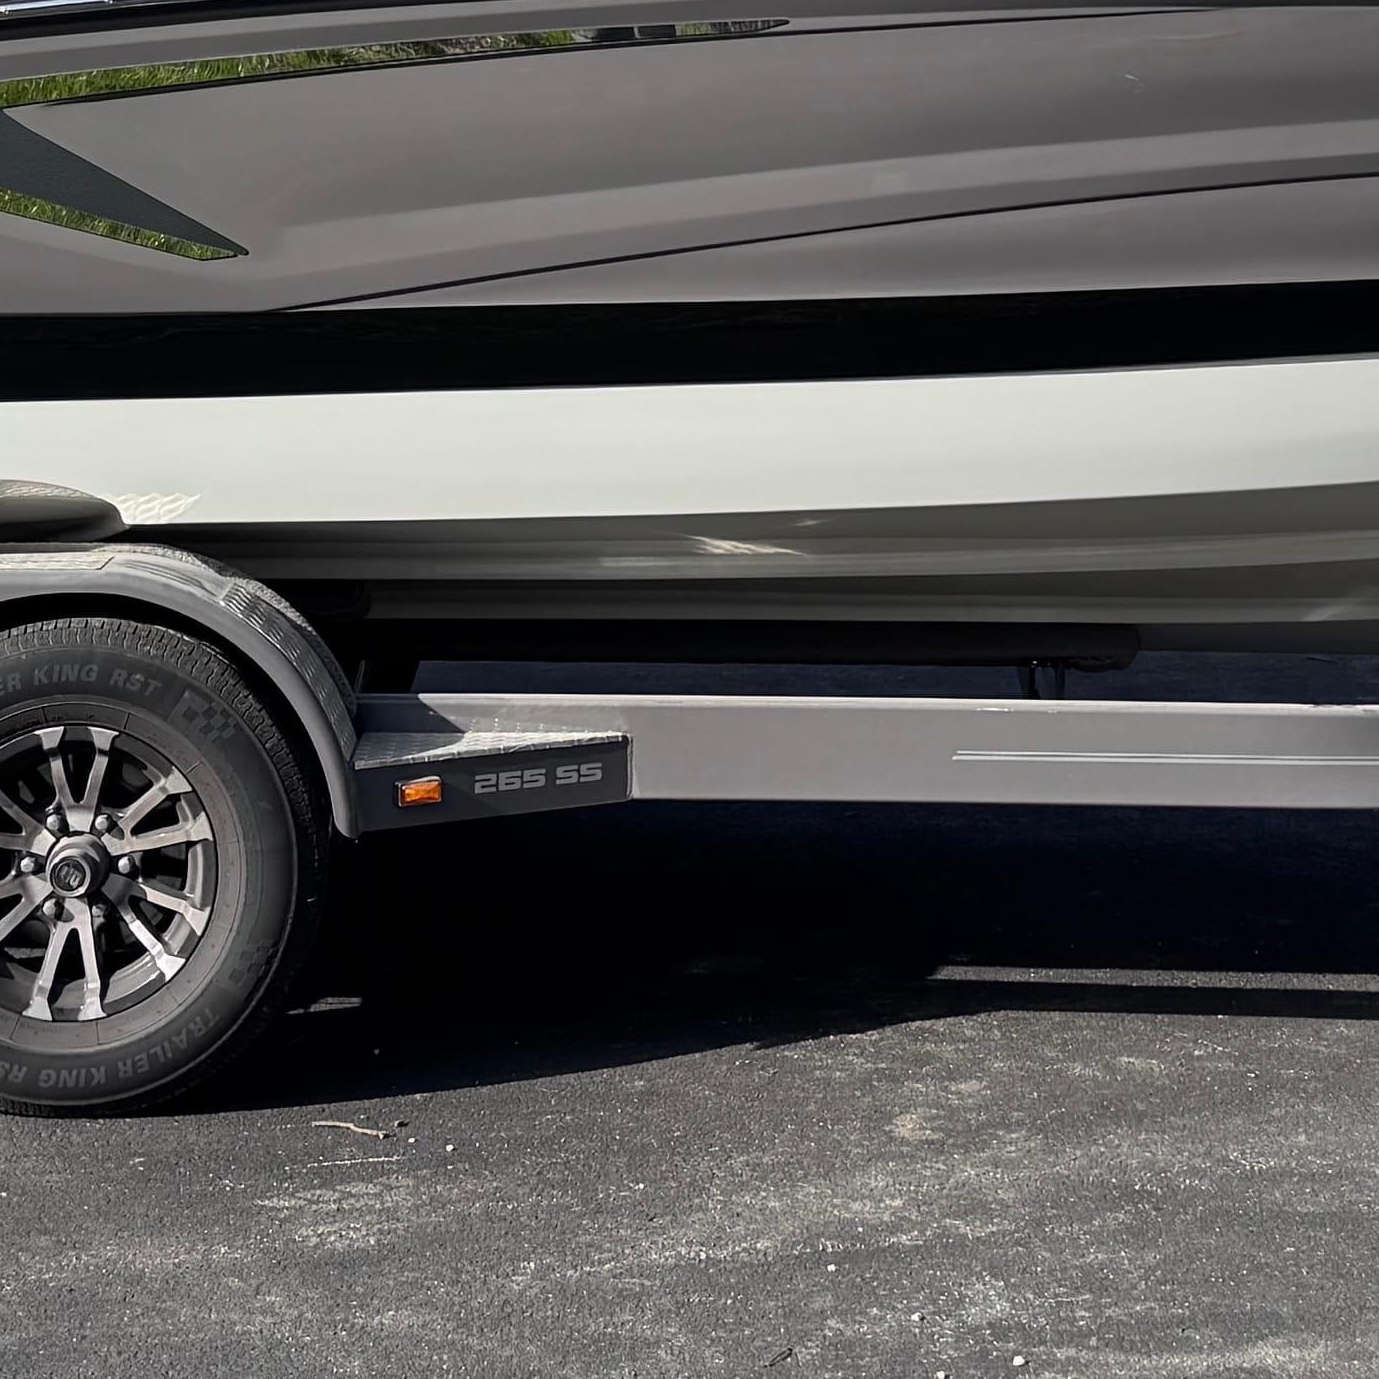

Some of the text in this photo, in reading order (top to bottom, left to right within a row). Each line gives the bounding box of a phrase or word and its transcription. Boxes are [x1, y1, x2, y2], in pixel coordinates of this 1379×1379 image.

[33, 663, 99, 686] KING
[108, 667, 163, 697] RST
[474, 763, 602, 794] 265 SS
[118, 1007, 220, 1078] TRAILER
[38, 1066, 107, 1088] KING
